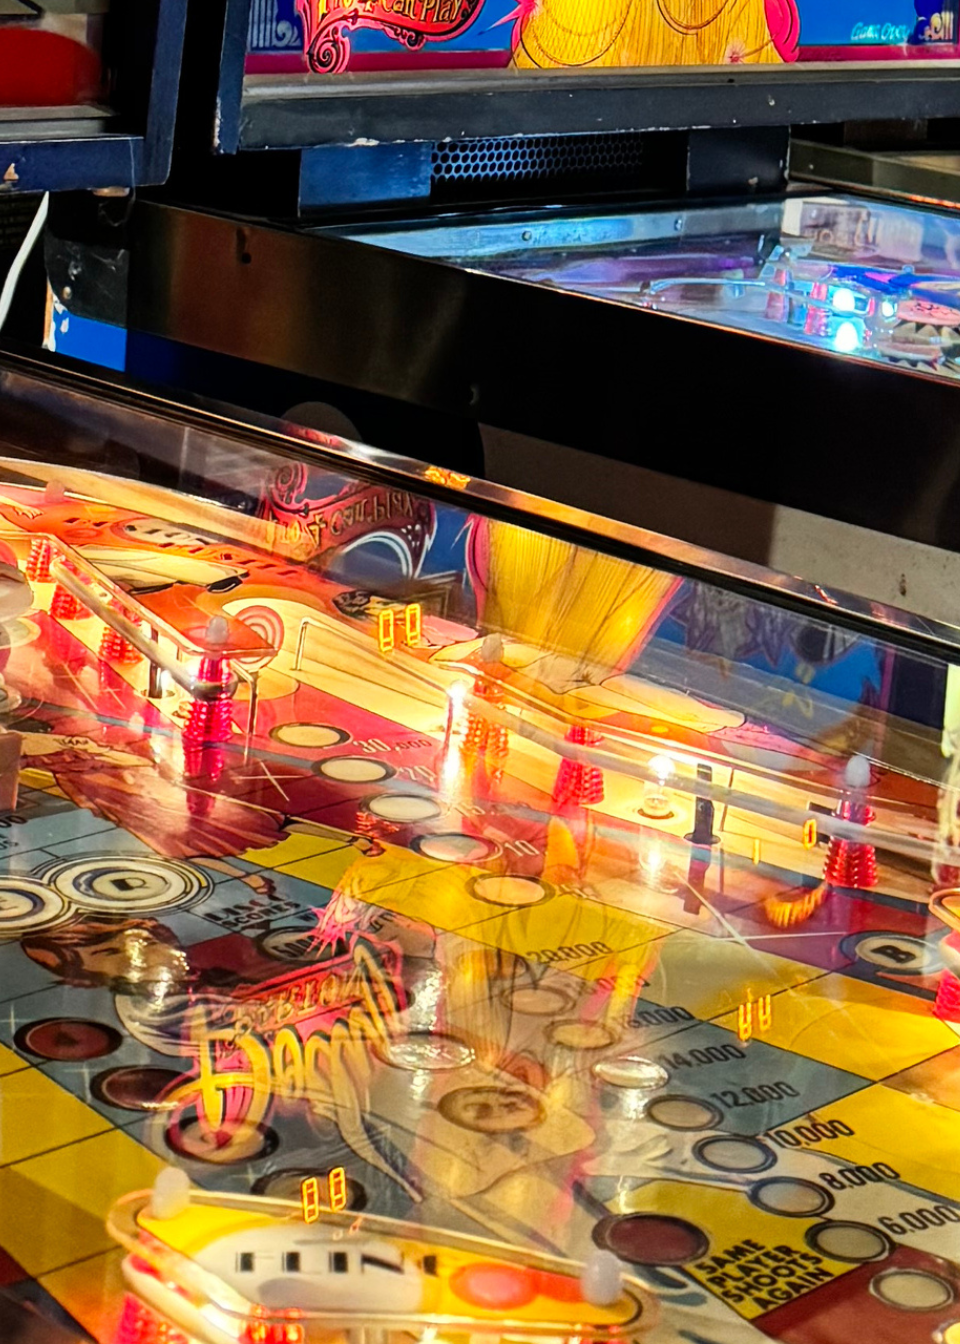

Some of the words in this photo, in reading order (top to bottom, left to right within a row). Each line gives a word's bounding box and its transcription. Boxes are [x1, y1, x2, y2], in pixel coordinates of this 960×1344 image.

[665, 1042, 748, 1071] 14,000
[710, 1079, 802, 1110] 12,000
[764, 1118, 857, 1149] 10,000
[818, 1161, 902, 1191] 8,000
[877, 1204, 960, 1237] 6,000
[694, 1238, 767, 1276] SAME
[706, 1244, 802, 1290] PLAYER
[721, 1252, 824, 1304] SHOOTS
[751, 1266, 836, 1311] AGAIN
